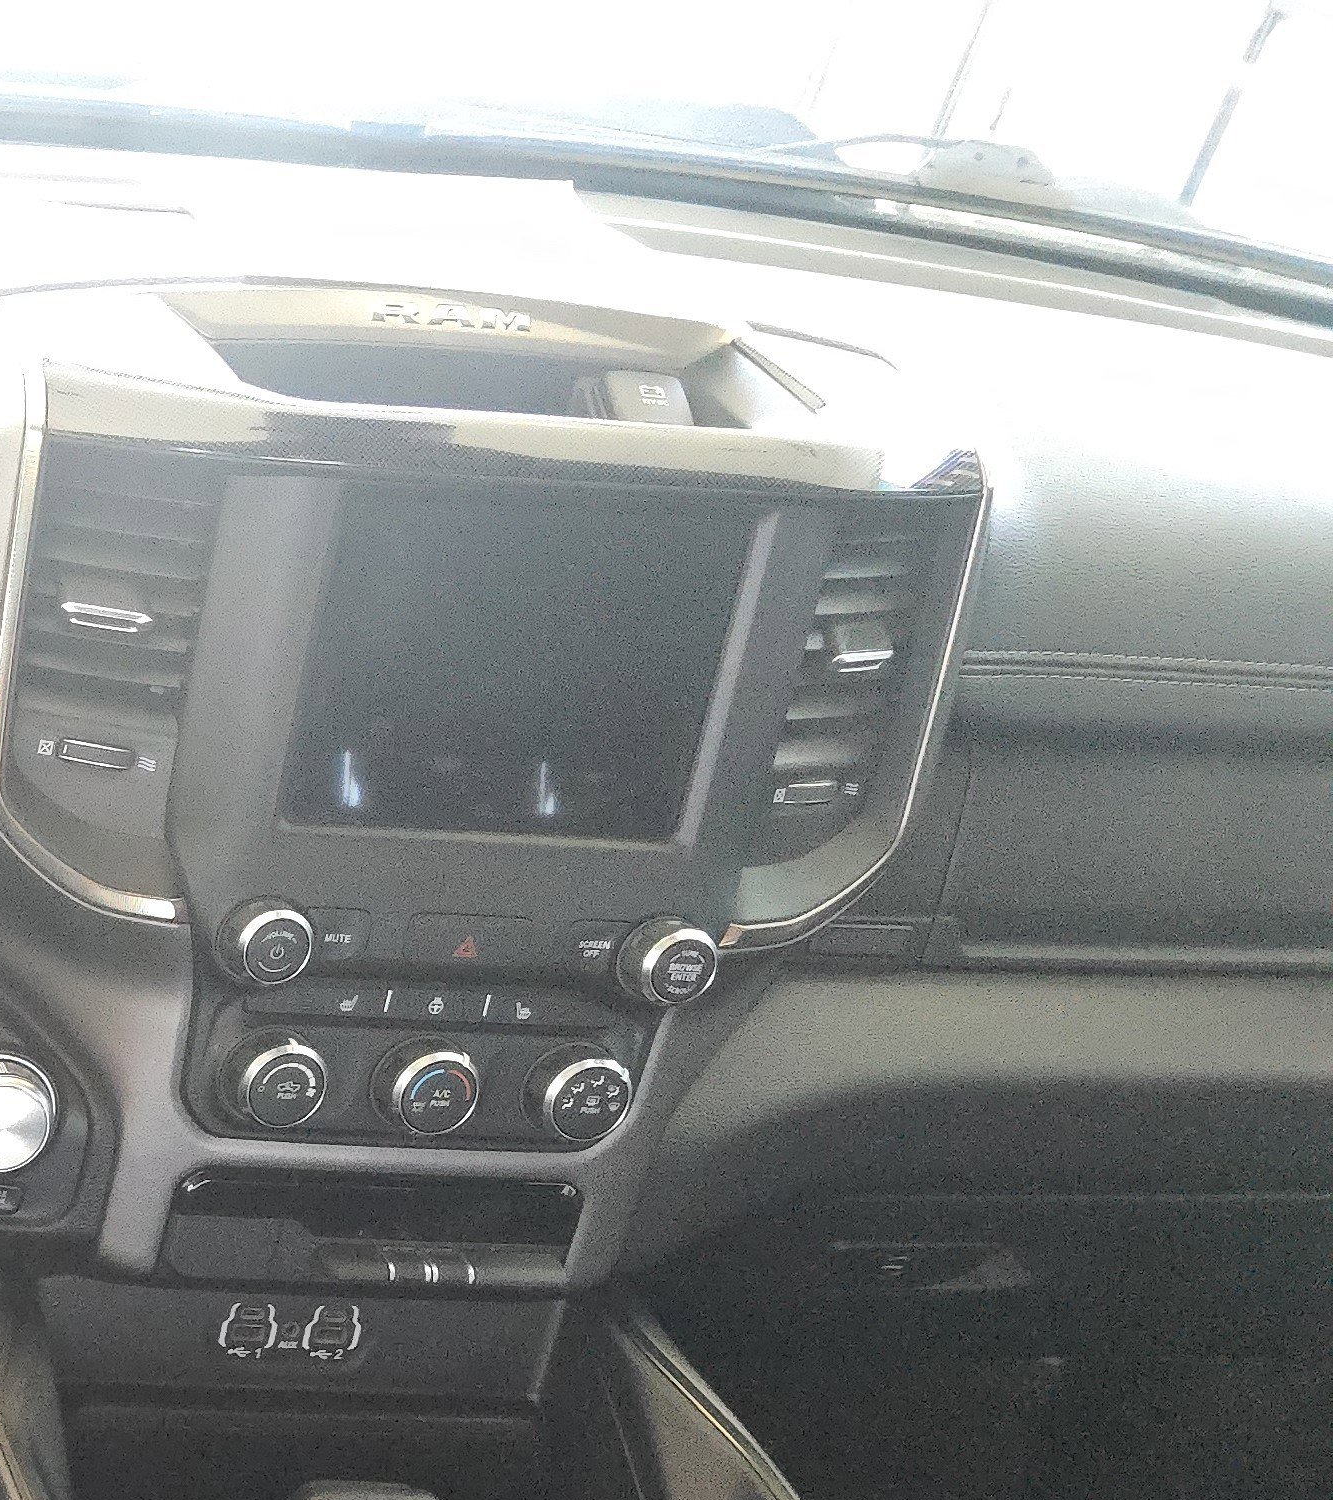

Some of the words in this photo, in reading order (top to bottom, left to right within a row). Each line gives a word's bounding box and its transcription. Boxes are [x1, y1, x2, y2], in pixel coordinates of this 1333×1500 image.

[371, 302, 531, 332] RAM
[324, 933, 351, 943] MUTE
[578, 940, 611, 949] SCREEN
[583, 950, 600, 958] OFF
[669, 963, 703, 972] BROWSE
[671, 973, 697, 982] ENTER
[433, 1089, 451, 1098] A/C
[255, 1348, 262, 1358] 1
[332, 1349, 343, 1359] 2
